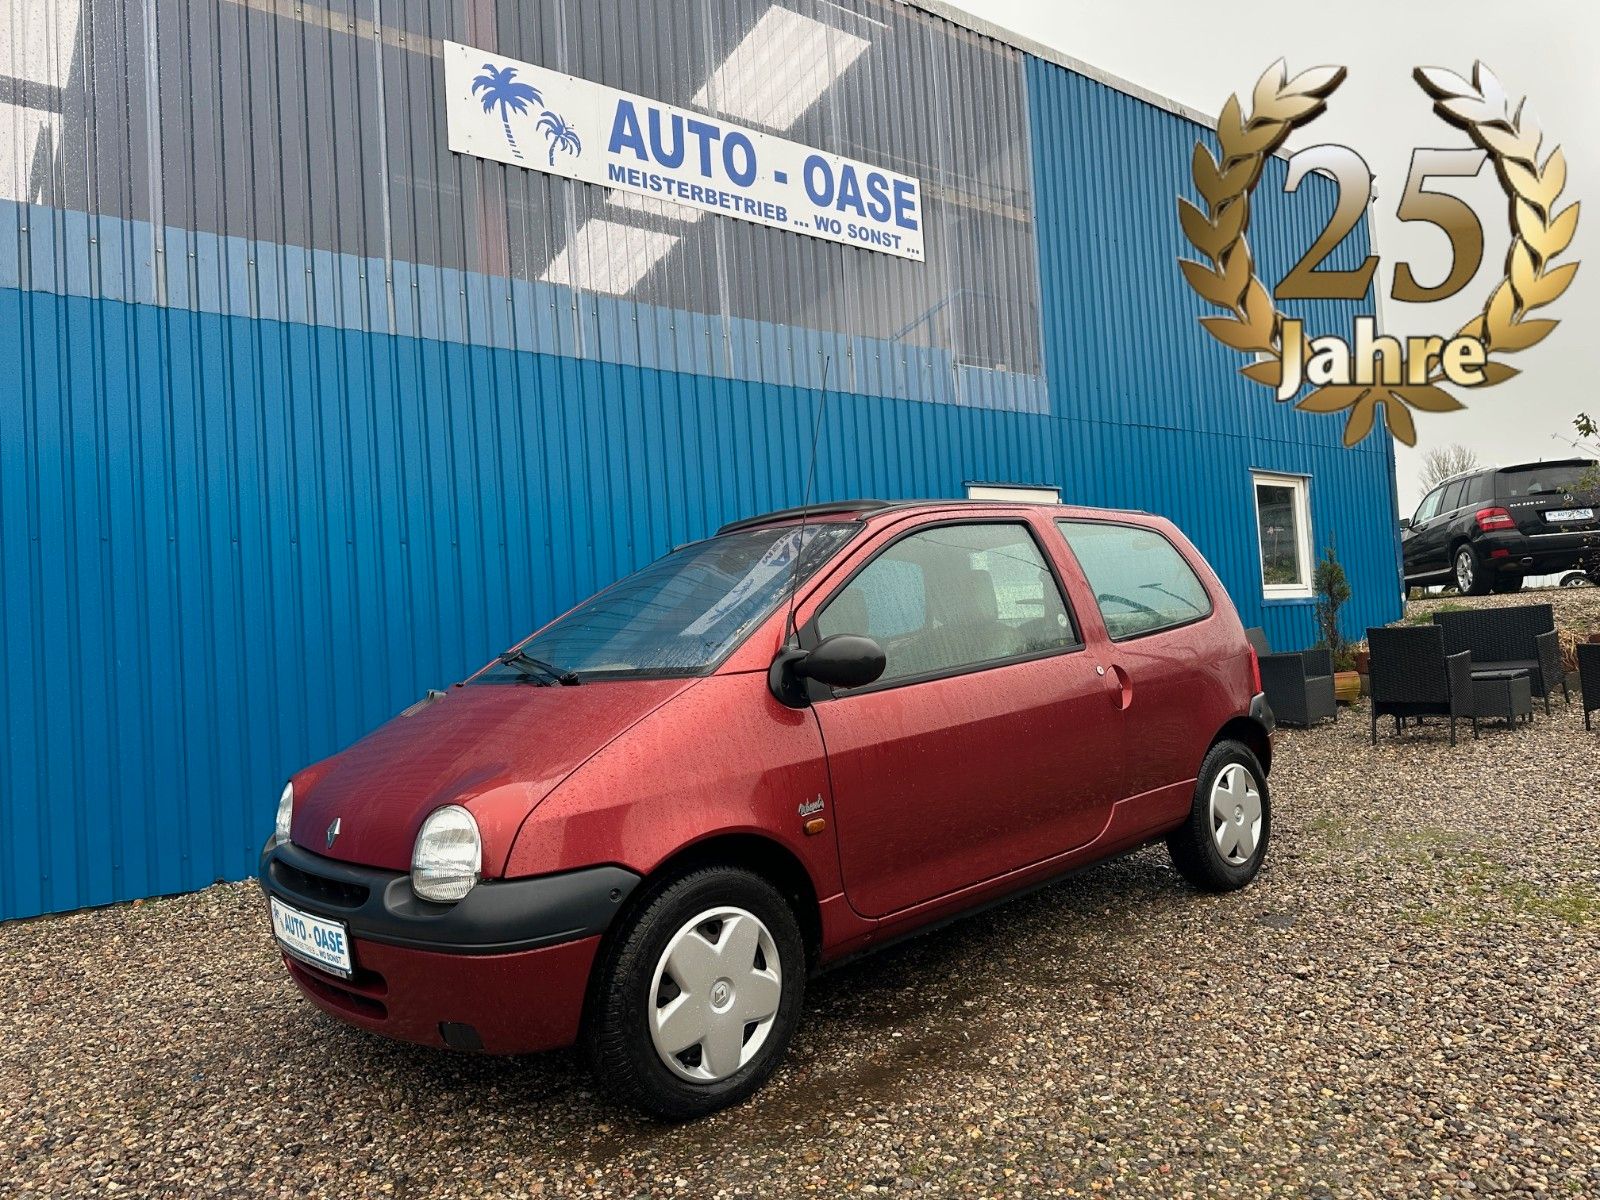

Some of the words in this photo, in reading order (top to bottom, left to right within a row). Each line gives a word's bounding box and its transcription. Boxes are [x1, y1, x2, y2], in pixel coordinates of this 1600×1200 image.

[608, 98, 757, 188] AUTO
[773, 170, 788, 185] -
[803, 154, 918, 231] OASE
[608, 163, 788, 223] MEISTERBETRIEB
[814, 214, 842, 235] WO
[848, 223, 902, 250] SONST
[284, 913, 307, 941] AUTO
[313, 926, 345, 955] OASE
